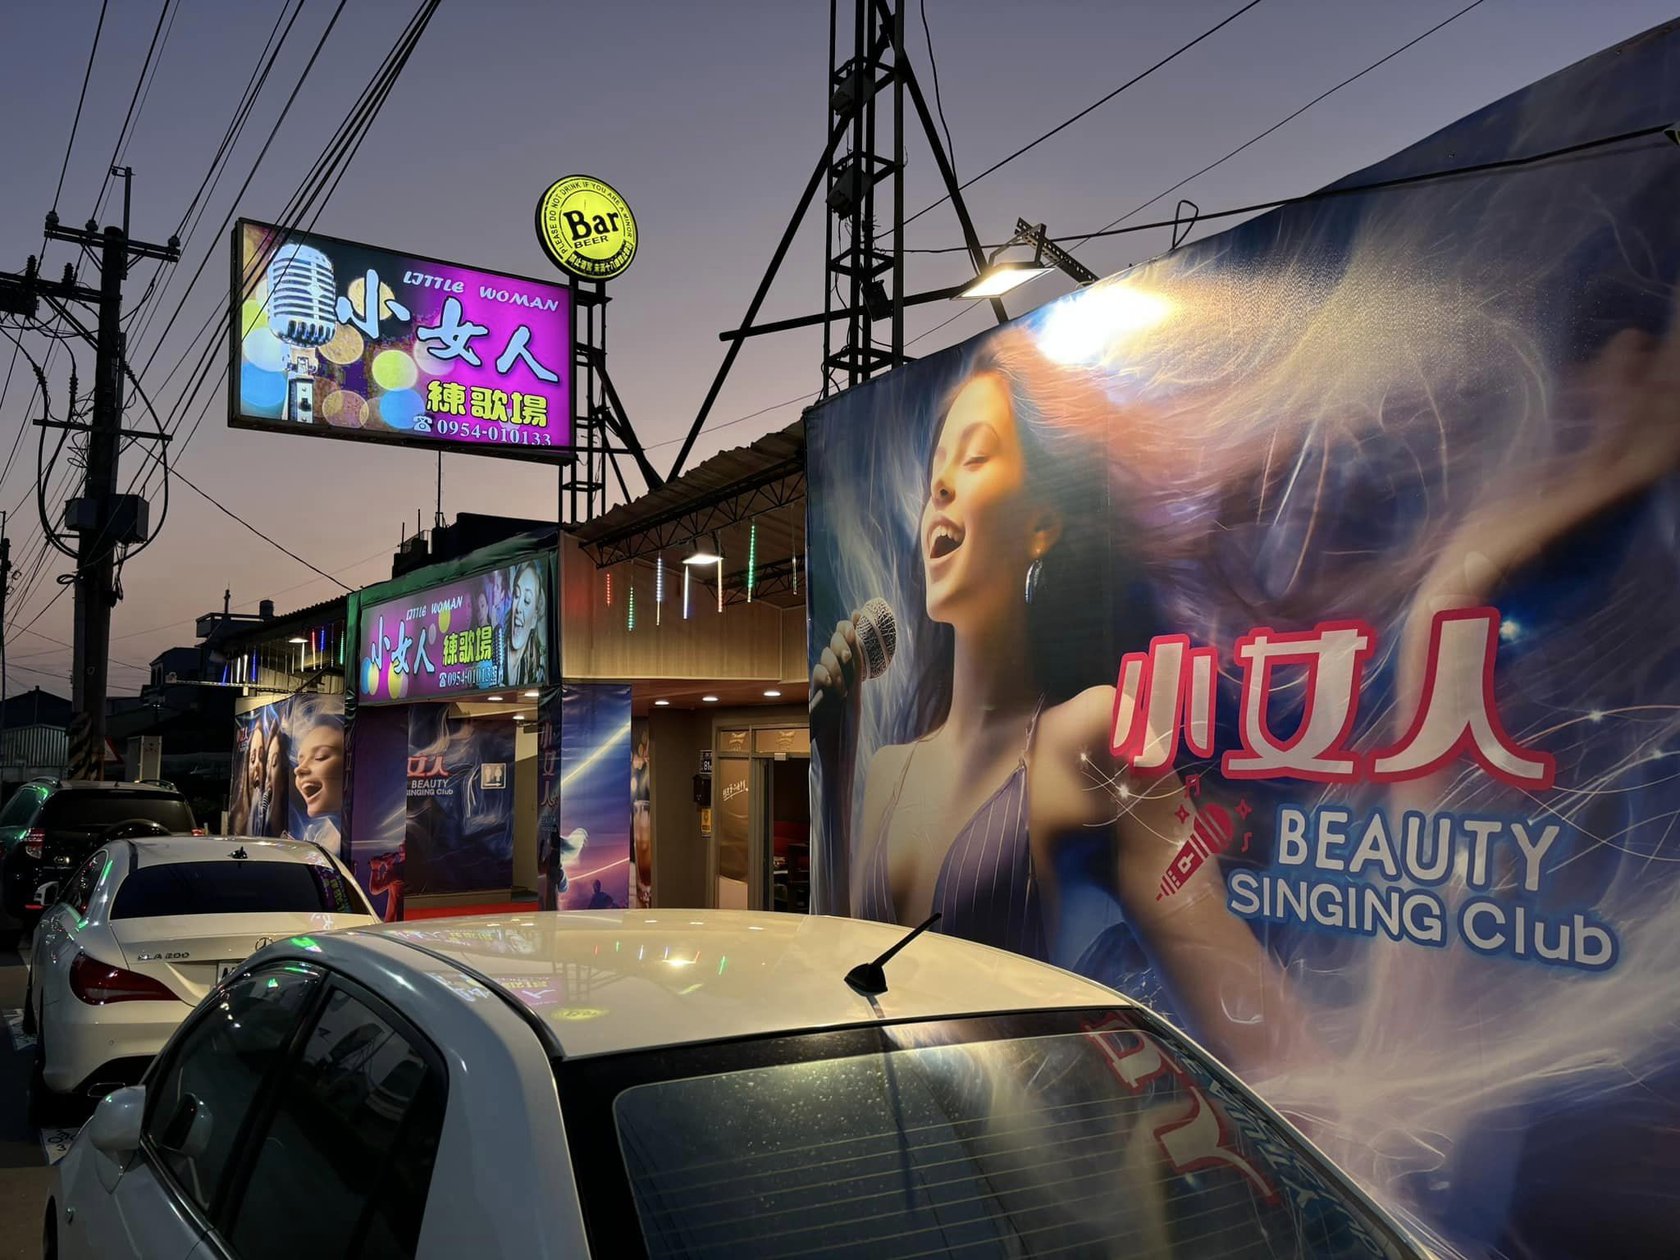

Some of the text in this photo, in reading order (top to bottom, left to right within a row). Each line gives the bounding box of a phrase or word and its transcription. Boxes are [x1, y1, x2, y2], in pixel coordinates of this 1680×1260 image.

[551, 193, 563, 208] NOT
[560, 182, 581, 196] DRINK
[591, 182, 608, 193] YOU
[608, 192, 621, 206] ARE
[549, 210, 557, 221] DO
[563, 210, 619, 241] Bar
[549, 224, 568, 254] PLEASE
[573, 234, 609, 249] BEER
[479, 286, 559, 312] WOMAN
[335, 268, 560, 383] 小女人
[426, 380, 548, 428] 練歌場
[437, 419, 552, 446] 0954-010133
[431, 596, 463, 614] WOMAN
[371, 615, 436, 675] 小女人
[443, 625, 493, 666] 練歌場
[1110, 607, 1556, 790] 小女人
[411, 779, 449, 788] BEAUTY
[1278, 808, 1560, 892] BEAUTY
[1228, 872, 1614, 967] SINGING Club
[165, 951, 190, 960] 200
